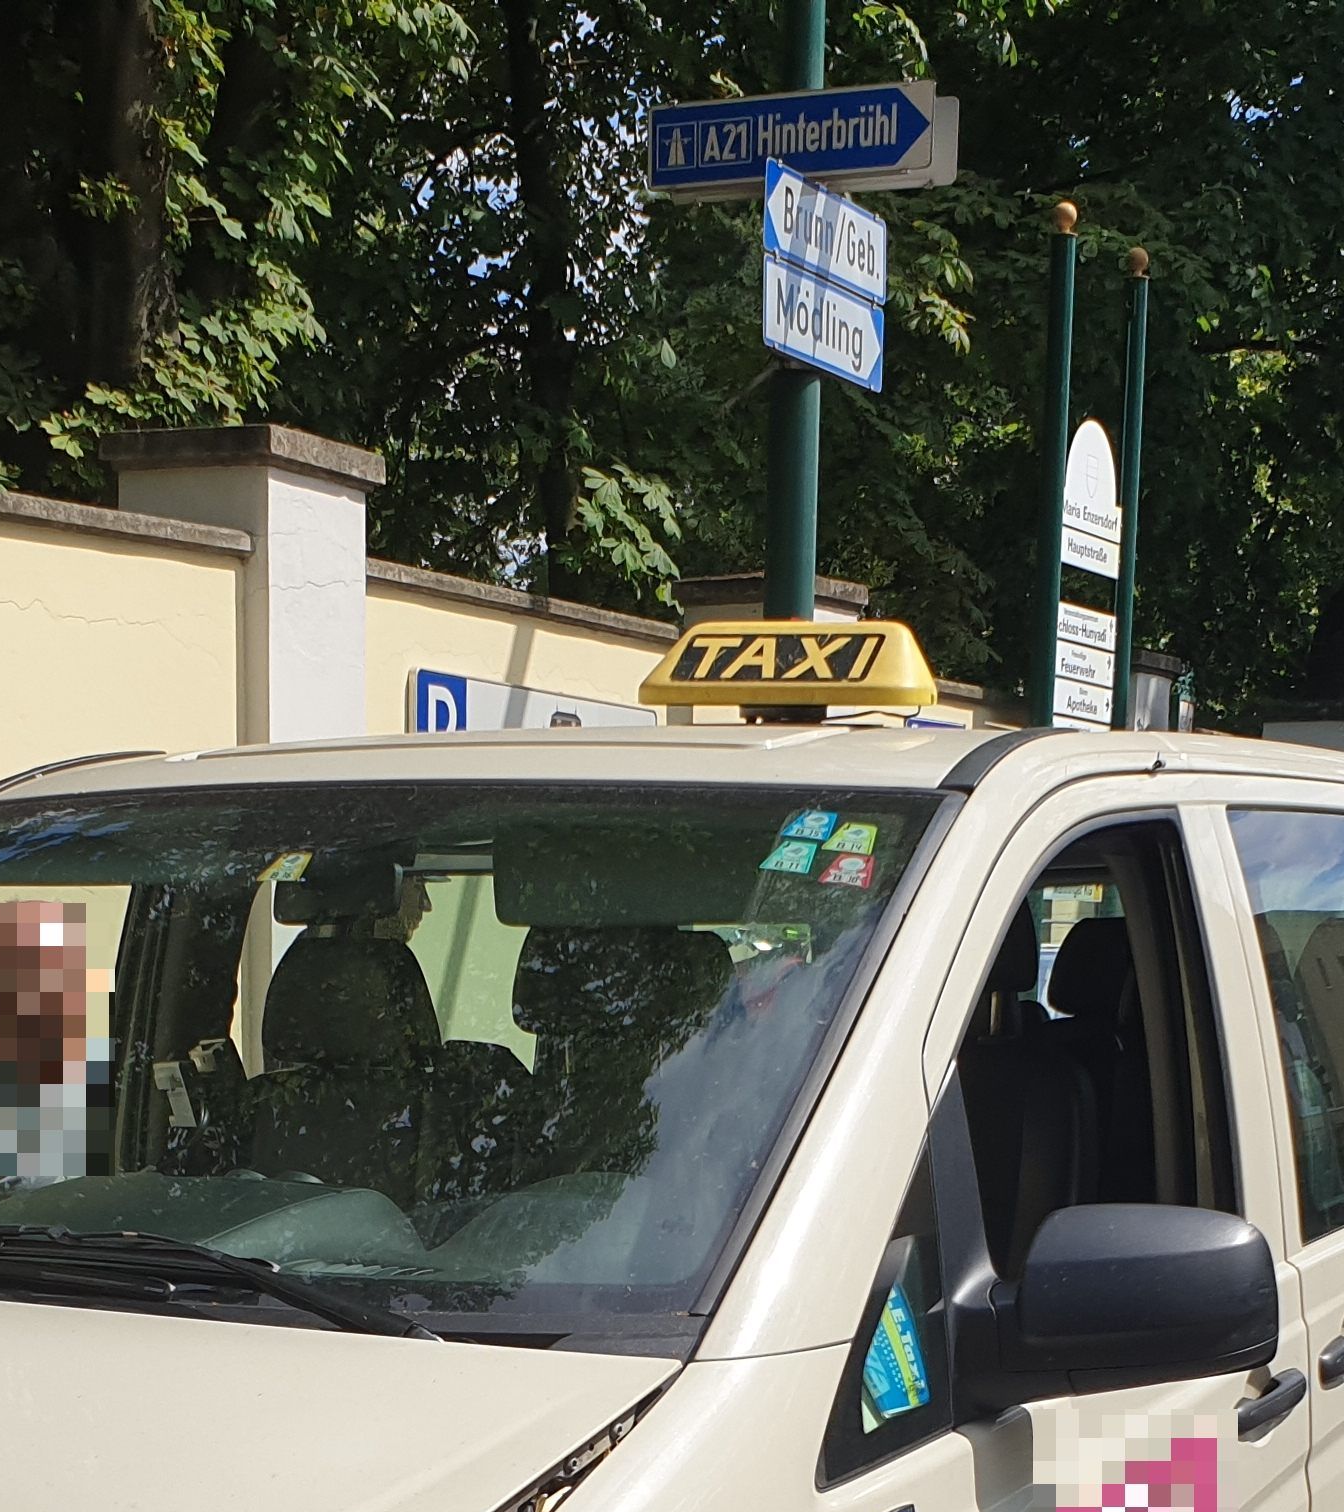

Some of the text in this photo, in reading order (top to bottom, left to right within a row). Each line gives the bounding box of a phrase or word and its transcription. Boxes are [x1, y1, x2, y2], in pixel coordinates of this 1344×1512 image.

[704, 103, 897, 161] A21 Hinterbrühl
[783, 186, 880, 280] Brunn/Geb.
[776, 278, 863, 373] Mödling
[1083, 506, 1118, 531] Enzersdorf
[1068, 537, 1108, 563] Hauptstraße
[1058, 618, 1107, 643] chloss-Hunyadi
[692, 637, 881, 679] TAXI
[1061, 657, 1096, 678] Feuerwehr
[1067, 696, 1098, 715] Apotheke
